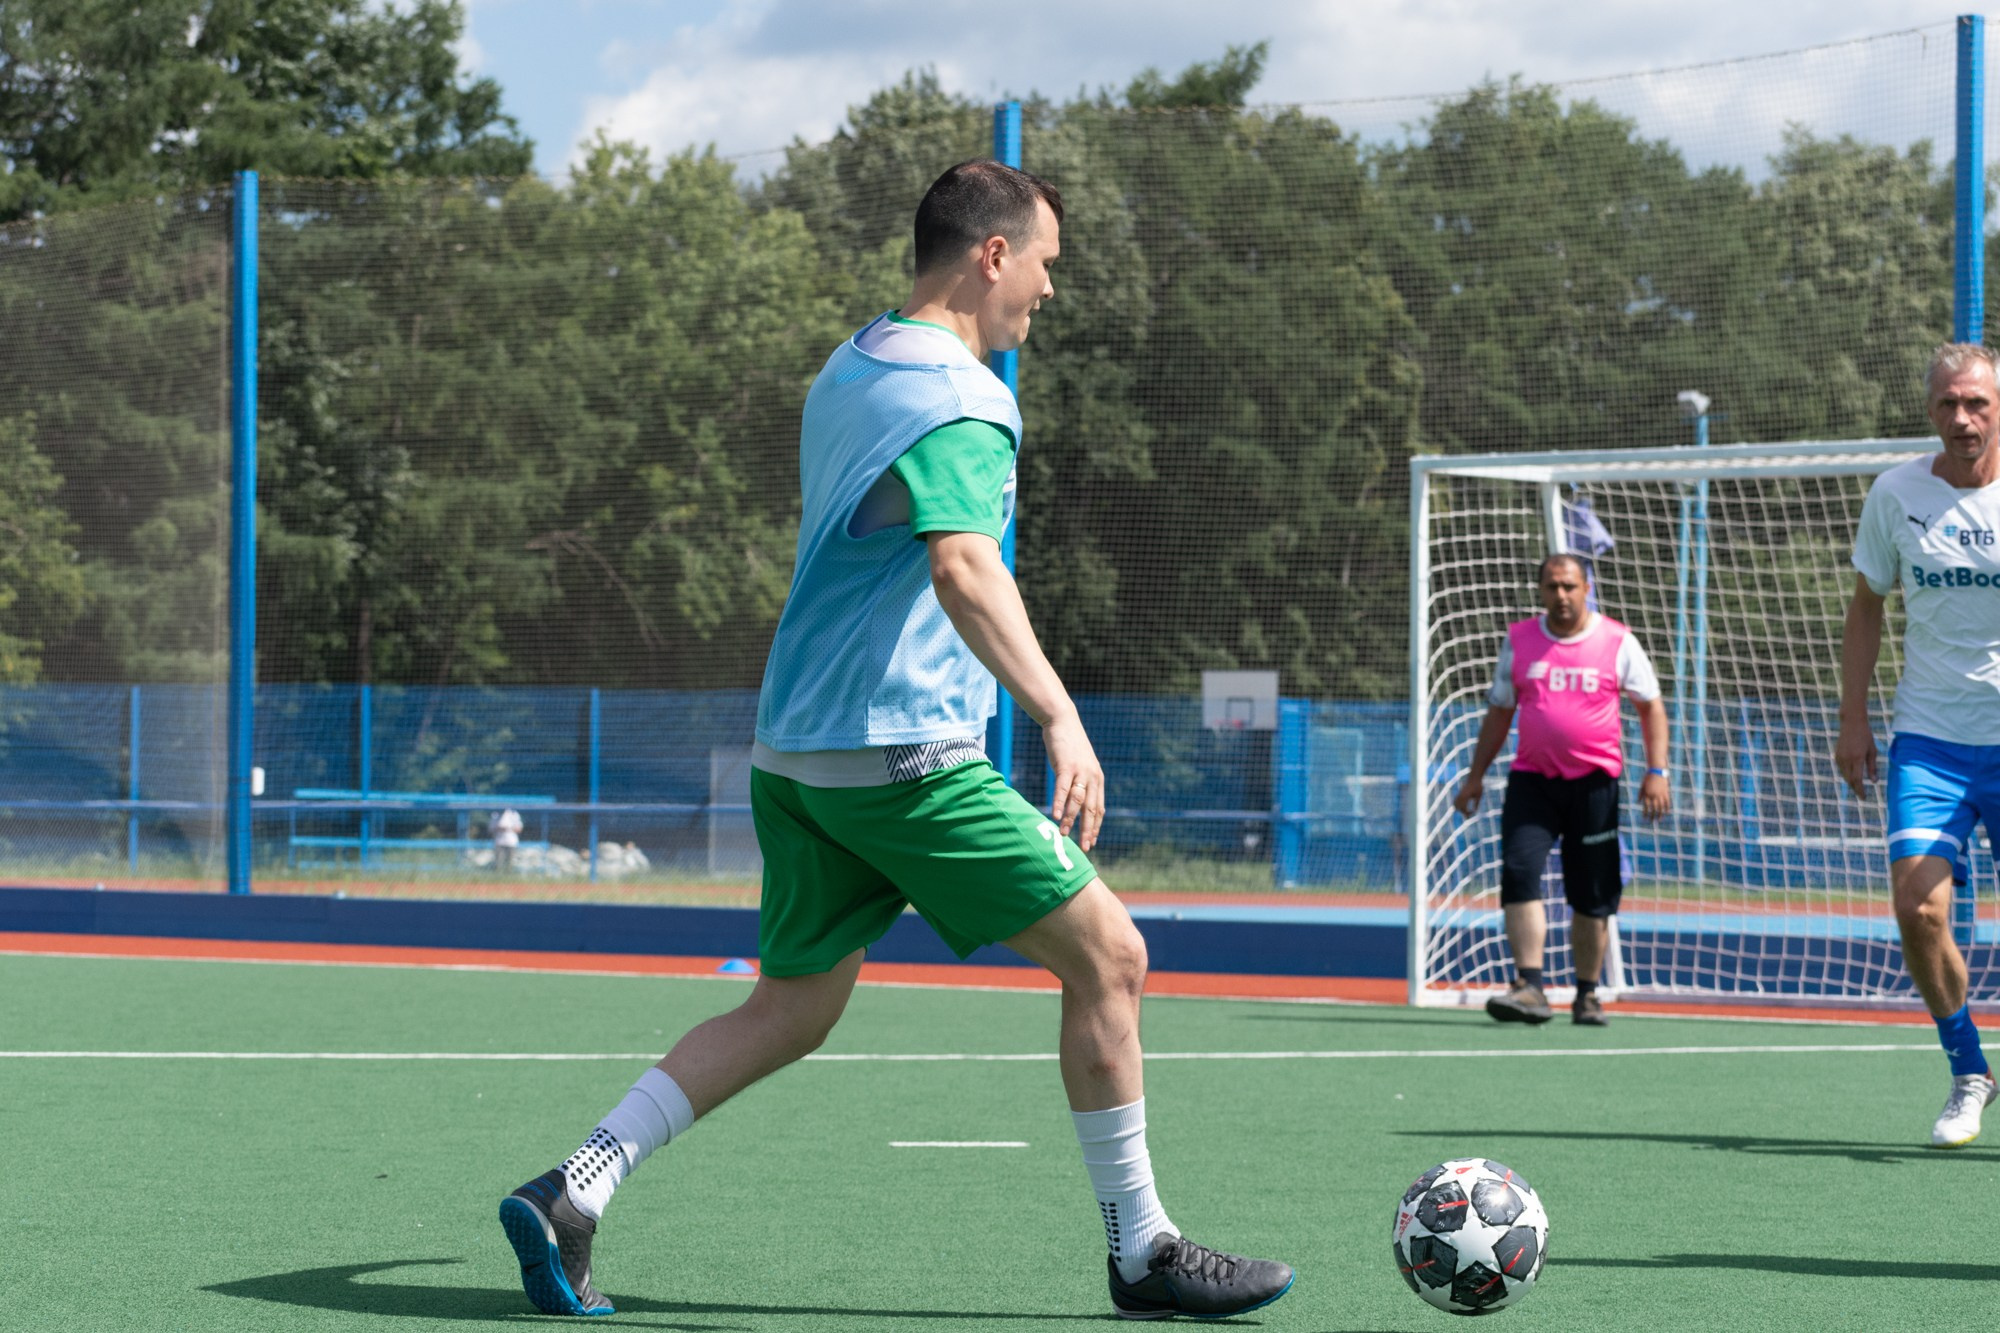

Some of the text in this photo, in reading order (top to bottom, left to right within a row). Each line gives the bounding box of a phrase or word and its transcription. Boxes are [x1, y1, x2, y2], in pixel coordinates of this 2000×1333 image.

[1960, 530, 1994, 546] ВТБ
[1549, 666, 1600, 693] ВТБ
[1036, 820, 1074, 872] 7
